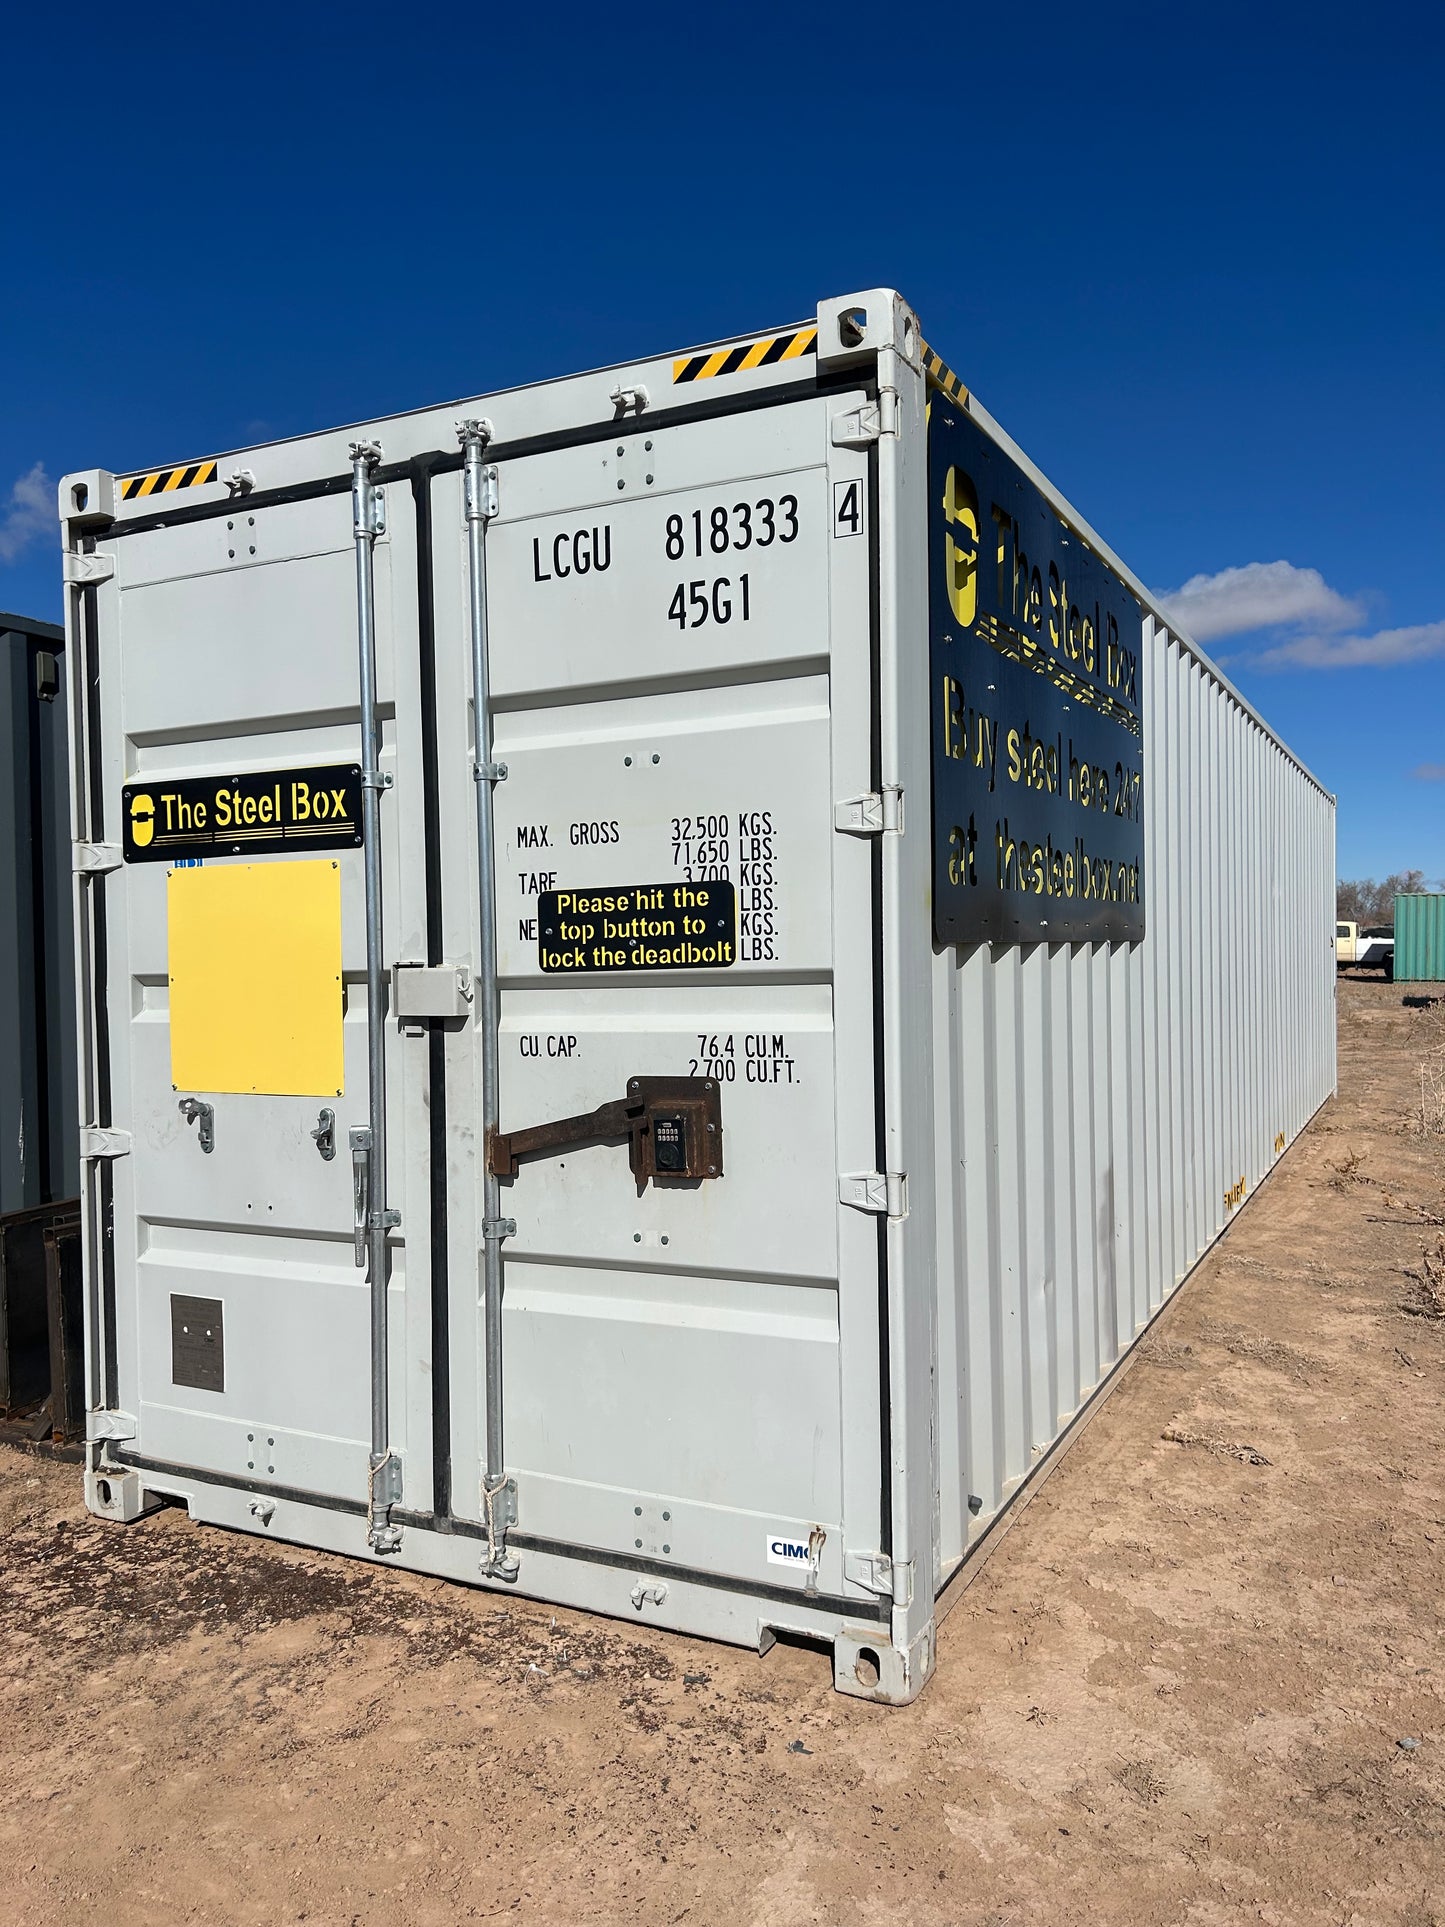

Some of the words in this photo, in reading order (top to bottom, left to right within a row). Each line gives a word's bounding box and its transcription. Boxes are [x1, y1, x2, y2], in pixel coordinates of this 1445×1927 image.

[533, 525, 611, 582] LCGU
[665, 494, 799, 561] 818333
[838, 483, 859, 532] 4
[667, 573, 751, 630] 45G1
[990, 502, 1043, 632] The
[1049, 560, 1101, 678] Steel
[944, 675, 998, 792] Buy
[1007, 720, 1062, 797] steel
[1068, 739, 1109, 813] here
[161, 794, 207, 830] The
[215, 784, 281, 826] Steel
[292, 782, 348, 821] Box
[517, 825, 554, 848] MAX.
[570, 821, 620, 845] GROSS
[671, 815, 729, 841] 32,500
[739, 812, 778, 837] KGS.
[672, 840, 729, 865] 71,650
[739, 837, 778, 861] LBS.
[948, 811, 977, 887] at
[683, 865, 729, 882] 3700
[740, 863, 778, 887] KGS.
[557, 893, 630, 915] Please
[636, 889, 665, 911] hit
[673, 887, 709, 908] the
[740, 888, 778, 911] LBS.
[519, 919, 538, 940] NE
[741, 912, 779, 937] KGS.
[560, 921, 595, 945] top
[603, 918, 676, 939] button
[682, 915, 706, 935] to
[542, 947, 587, 968] lock
[593, 946, 627, 966] the
[631, 941, 732, 966] deadbolt
[741, 938, 779, 961] LBS.
[698, 1035, 735, 1057] 76.4
[745, 1035, 789, 1058] CU.M.
[689, 1060, 736, 1082] 2700
[746, 1060, 800, 1083] CU.FT.
